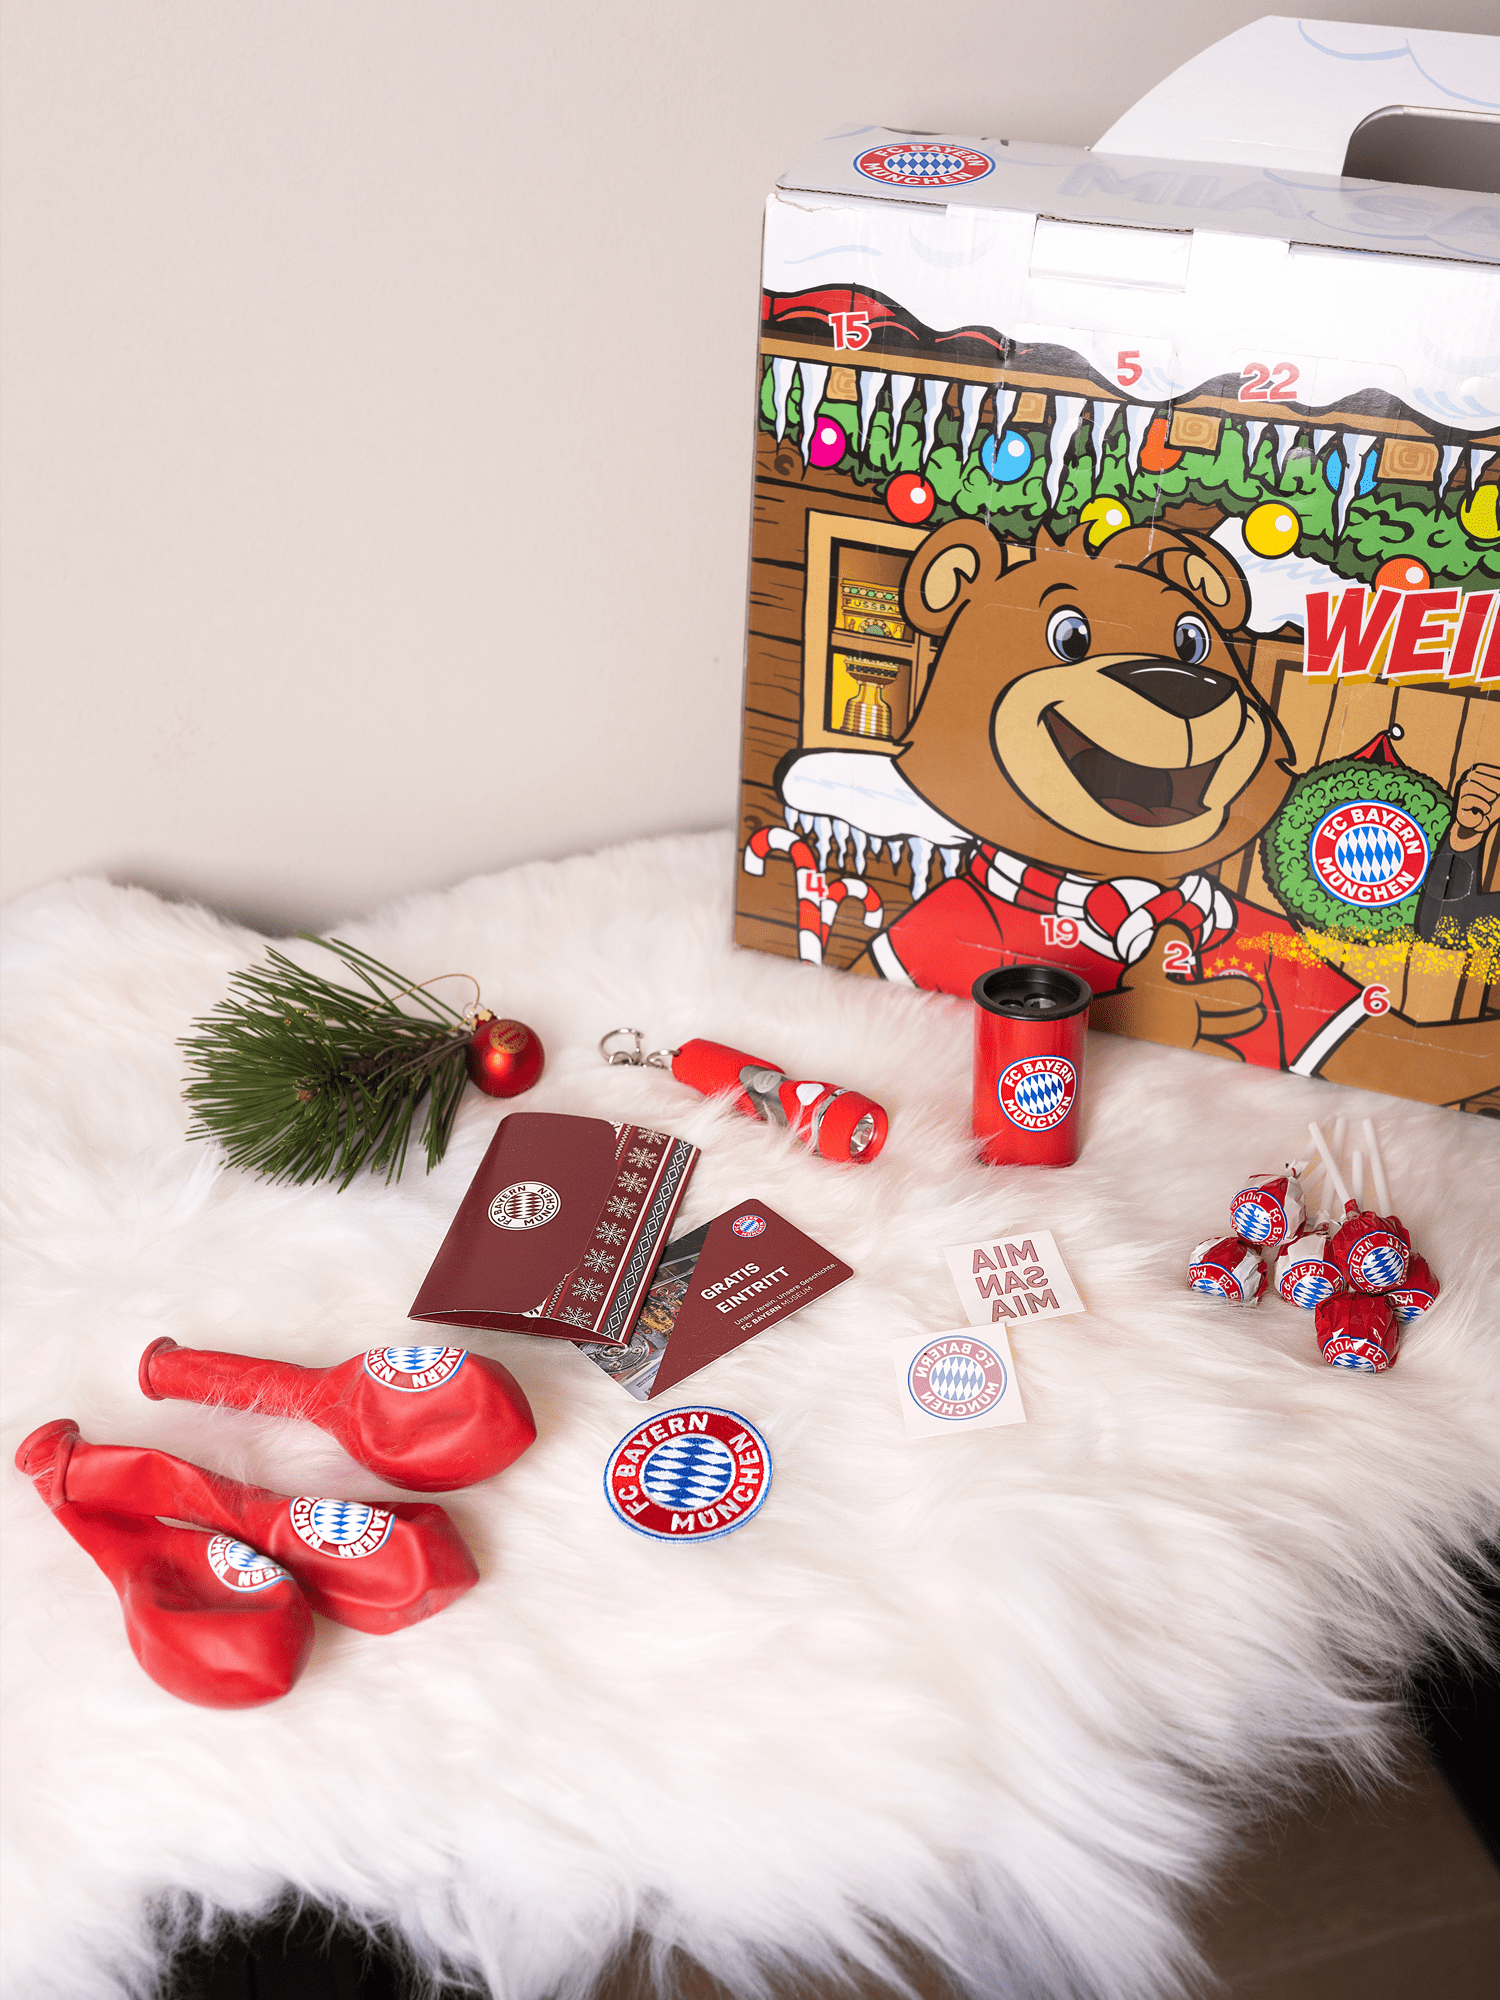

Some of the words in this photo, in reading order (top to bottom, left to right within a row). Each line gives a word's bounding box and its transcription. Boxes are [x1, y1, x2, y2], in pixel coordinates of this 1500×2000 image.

[875, 146, 904, 157] FC
[910, 145, 986, 167] BAYERN
[1056, 162, 1304, 220] MIA
[828, 311, 872, 351] 15
[1116, 349, 1143, 387] 5
[1239, 361, 1301, 401] 22
[1322, 816, 1348, 841] FC
[1350, 808, 1422, 855] BAYERN
[805, 872, 826, 898] 4
[1318, 856, 1415, 901] MÜNCHEN
[1040, 915, 1079, 948] 19
[1163, 940, 1192, 973] 2
[1361, 983, 1391, 1017] 6
[1004, 1069, 1022, 1087] FC
[1022, 1060, 1073, 1084] BAYERN
[1003, 1096, 1072, 1127] MÜNCHEN
[493, 1185, 526, 1216] BAYERN
[1269, 1207, 1282, 1223] FC
[497, 1216, 512, 1225] FC
[1265, 1227, 1283, 1246] BAY
[700, 1262, 761, 1301] GRATIS
[715, 1266, 790, 1314] EINTRITT
[733, 1311, 756, 1326] Unser
[776, 1284, 801, 1301] Unsere
[799, 1262, 839, 1287] Geschichte.
[740, 1321, 753, 1331] FC
[751, 1304, 783, 1325] BAYERN
[780, 1285, 814, 1307] MUSEUM
[411, 1347, 461, 1388] AYERN
[1365, 1346, 1382, 1362] FC
[614, 1413, 709, 1478] BAYERN
[618, 1484, 650, 1517] FC
[670, 1431, 760, 1532] MÜNCHEN
[294, 1497, 324, 1550] CHEN
